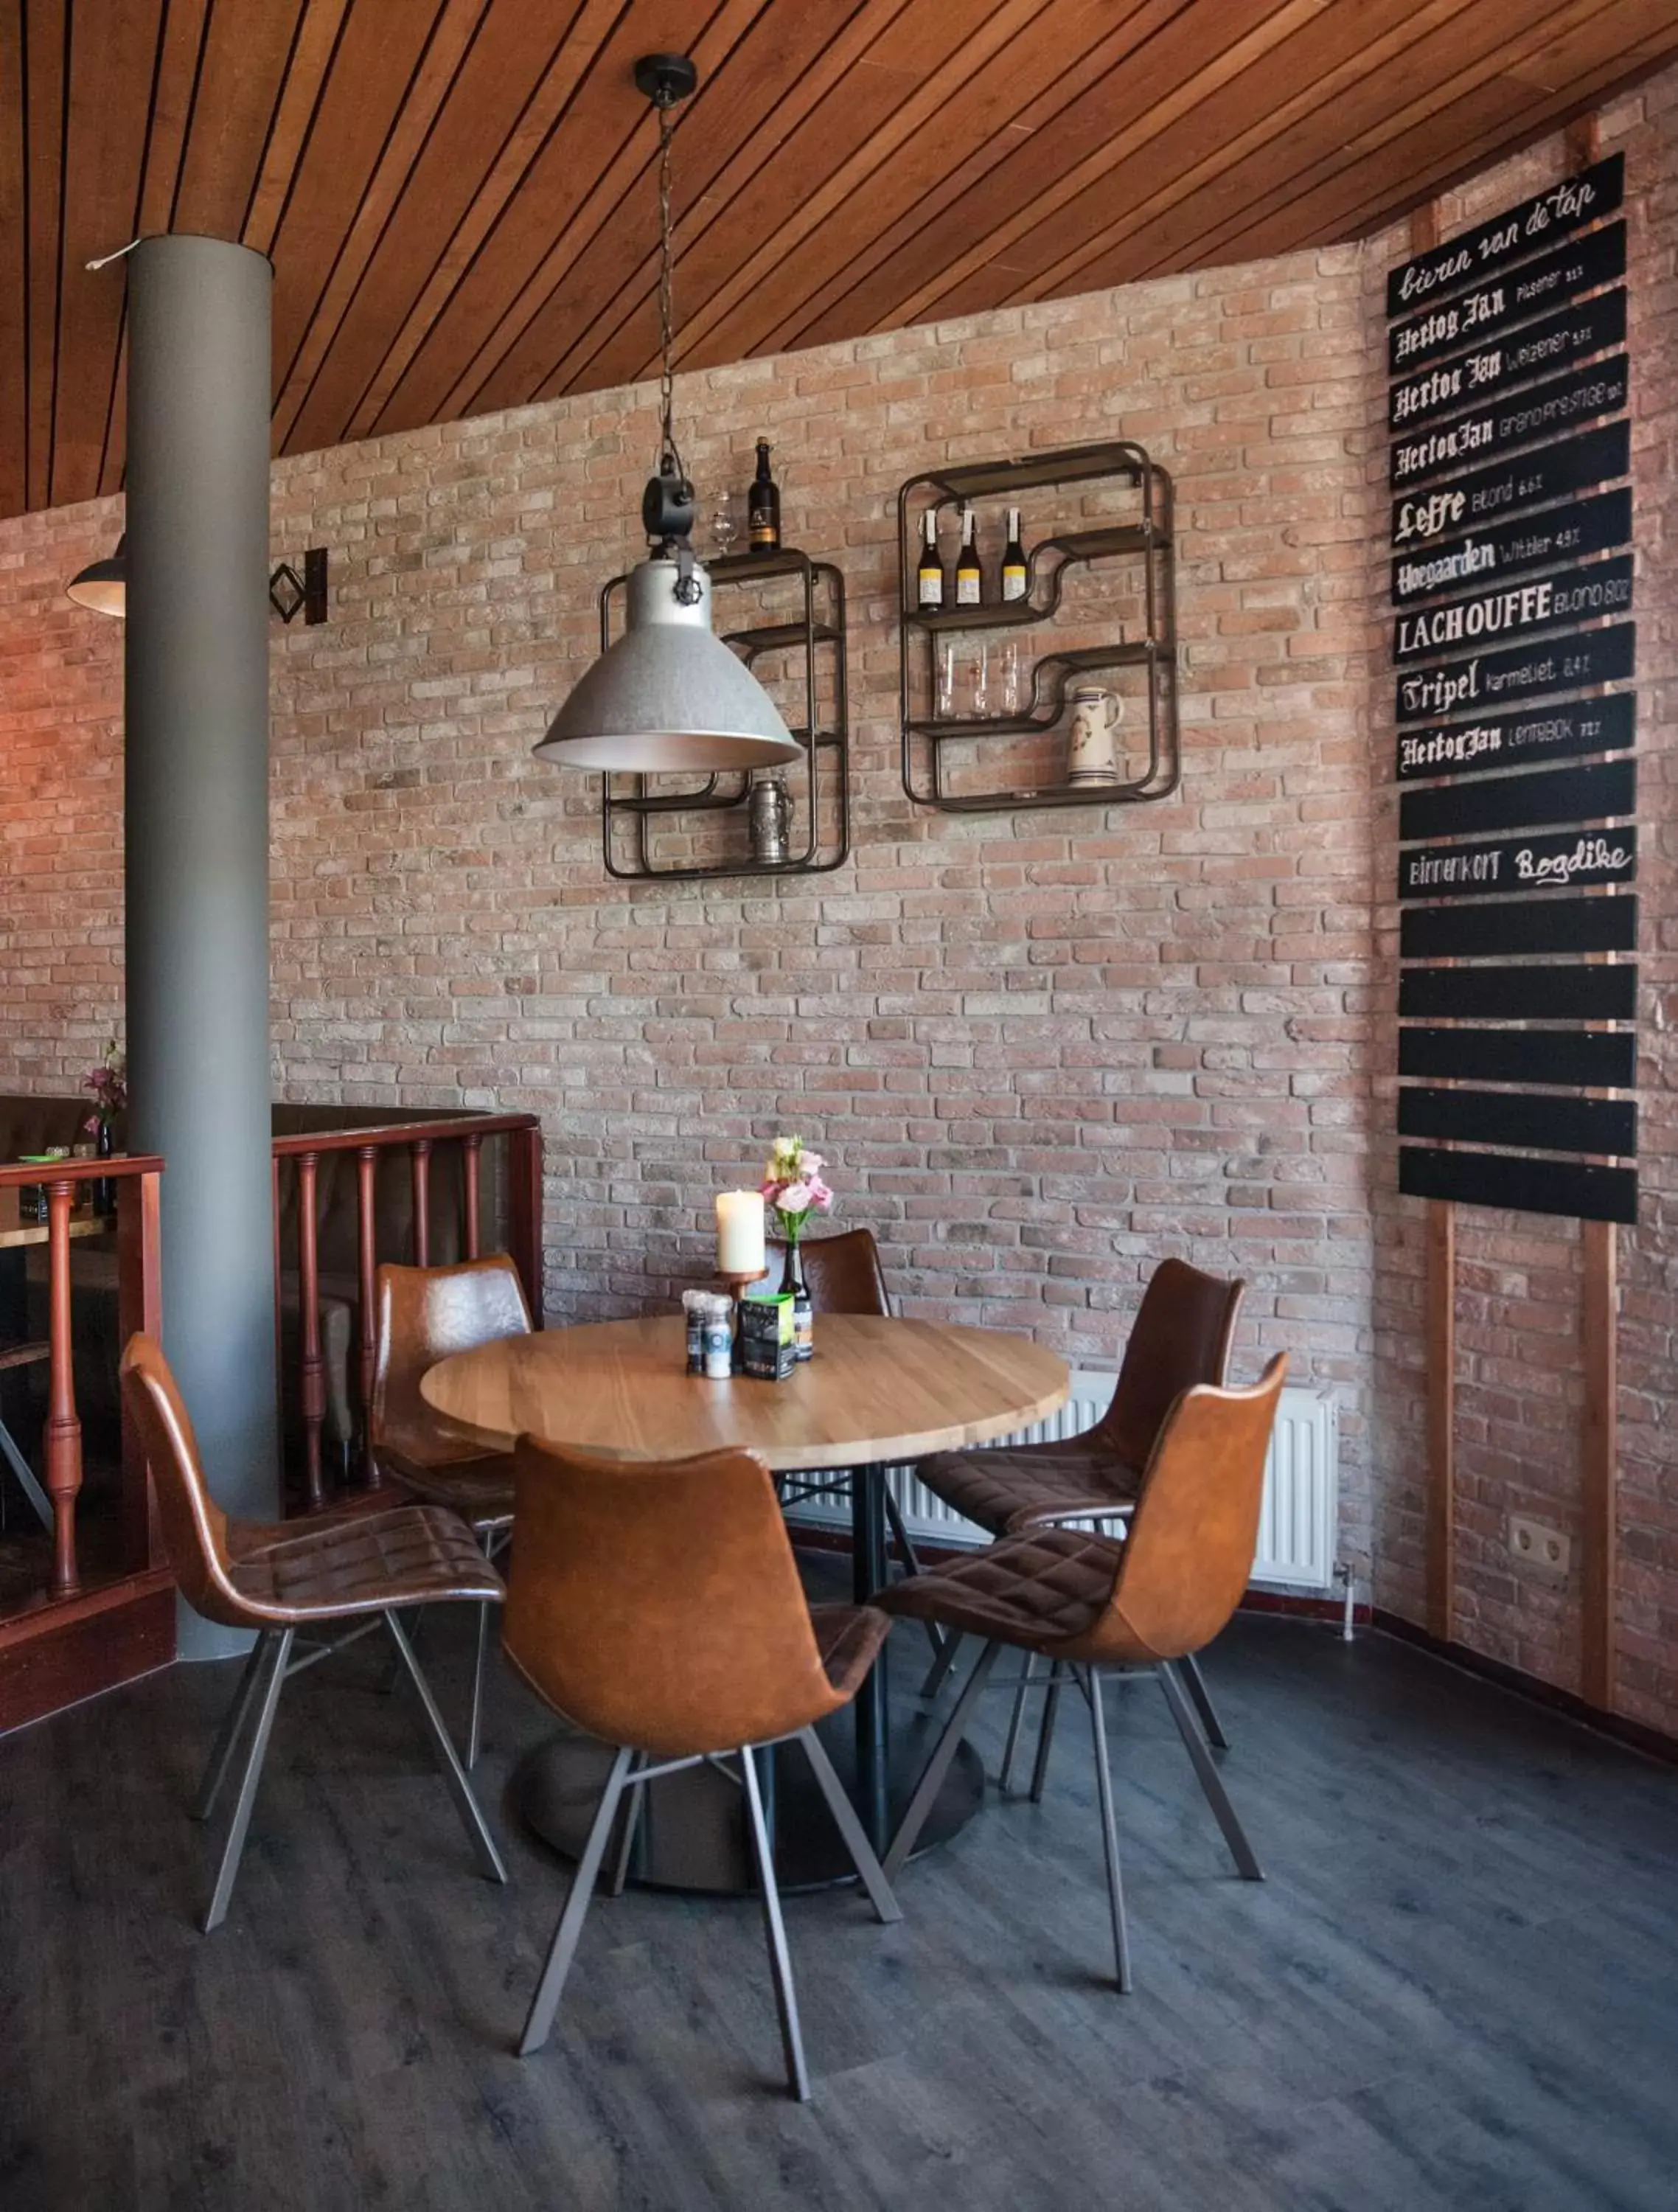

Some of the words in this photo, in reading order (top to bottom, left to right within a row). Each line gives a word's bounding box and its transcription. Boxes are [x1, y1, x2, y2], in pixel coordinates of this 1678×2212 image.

[1398, 249, 1472, 301] bieren
[1477, 222, 1519, 260] van
[1525, 202, 1550, 236] de
[1394, 309, 1460, 364] Hertog
[1461, 288, 1506, 333] Jan
[1393, 368, 1463, 423] Hertog
[1465, 349, 1503, 389] Jan
[1394, 490, 1467, 543] Leffe
[1397, 538, 1497, 596] Hoegaarden
[1402, 659, 1480, 714] Tripel
[1514, 838, 1634, 886] Bogdike
